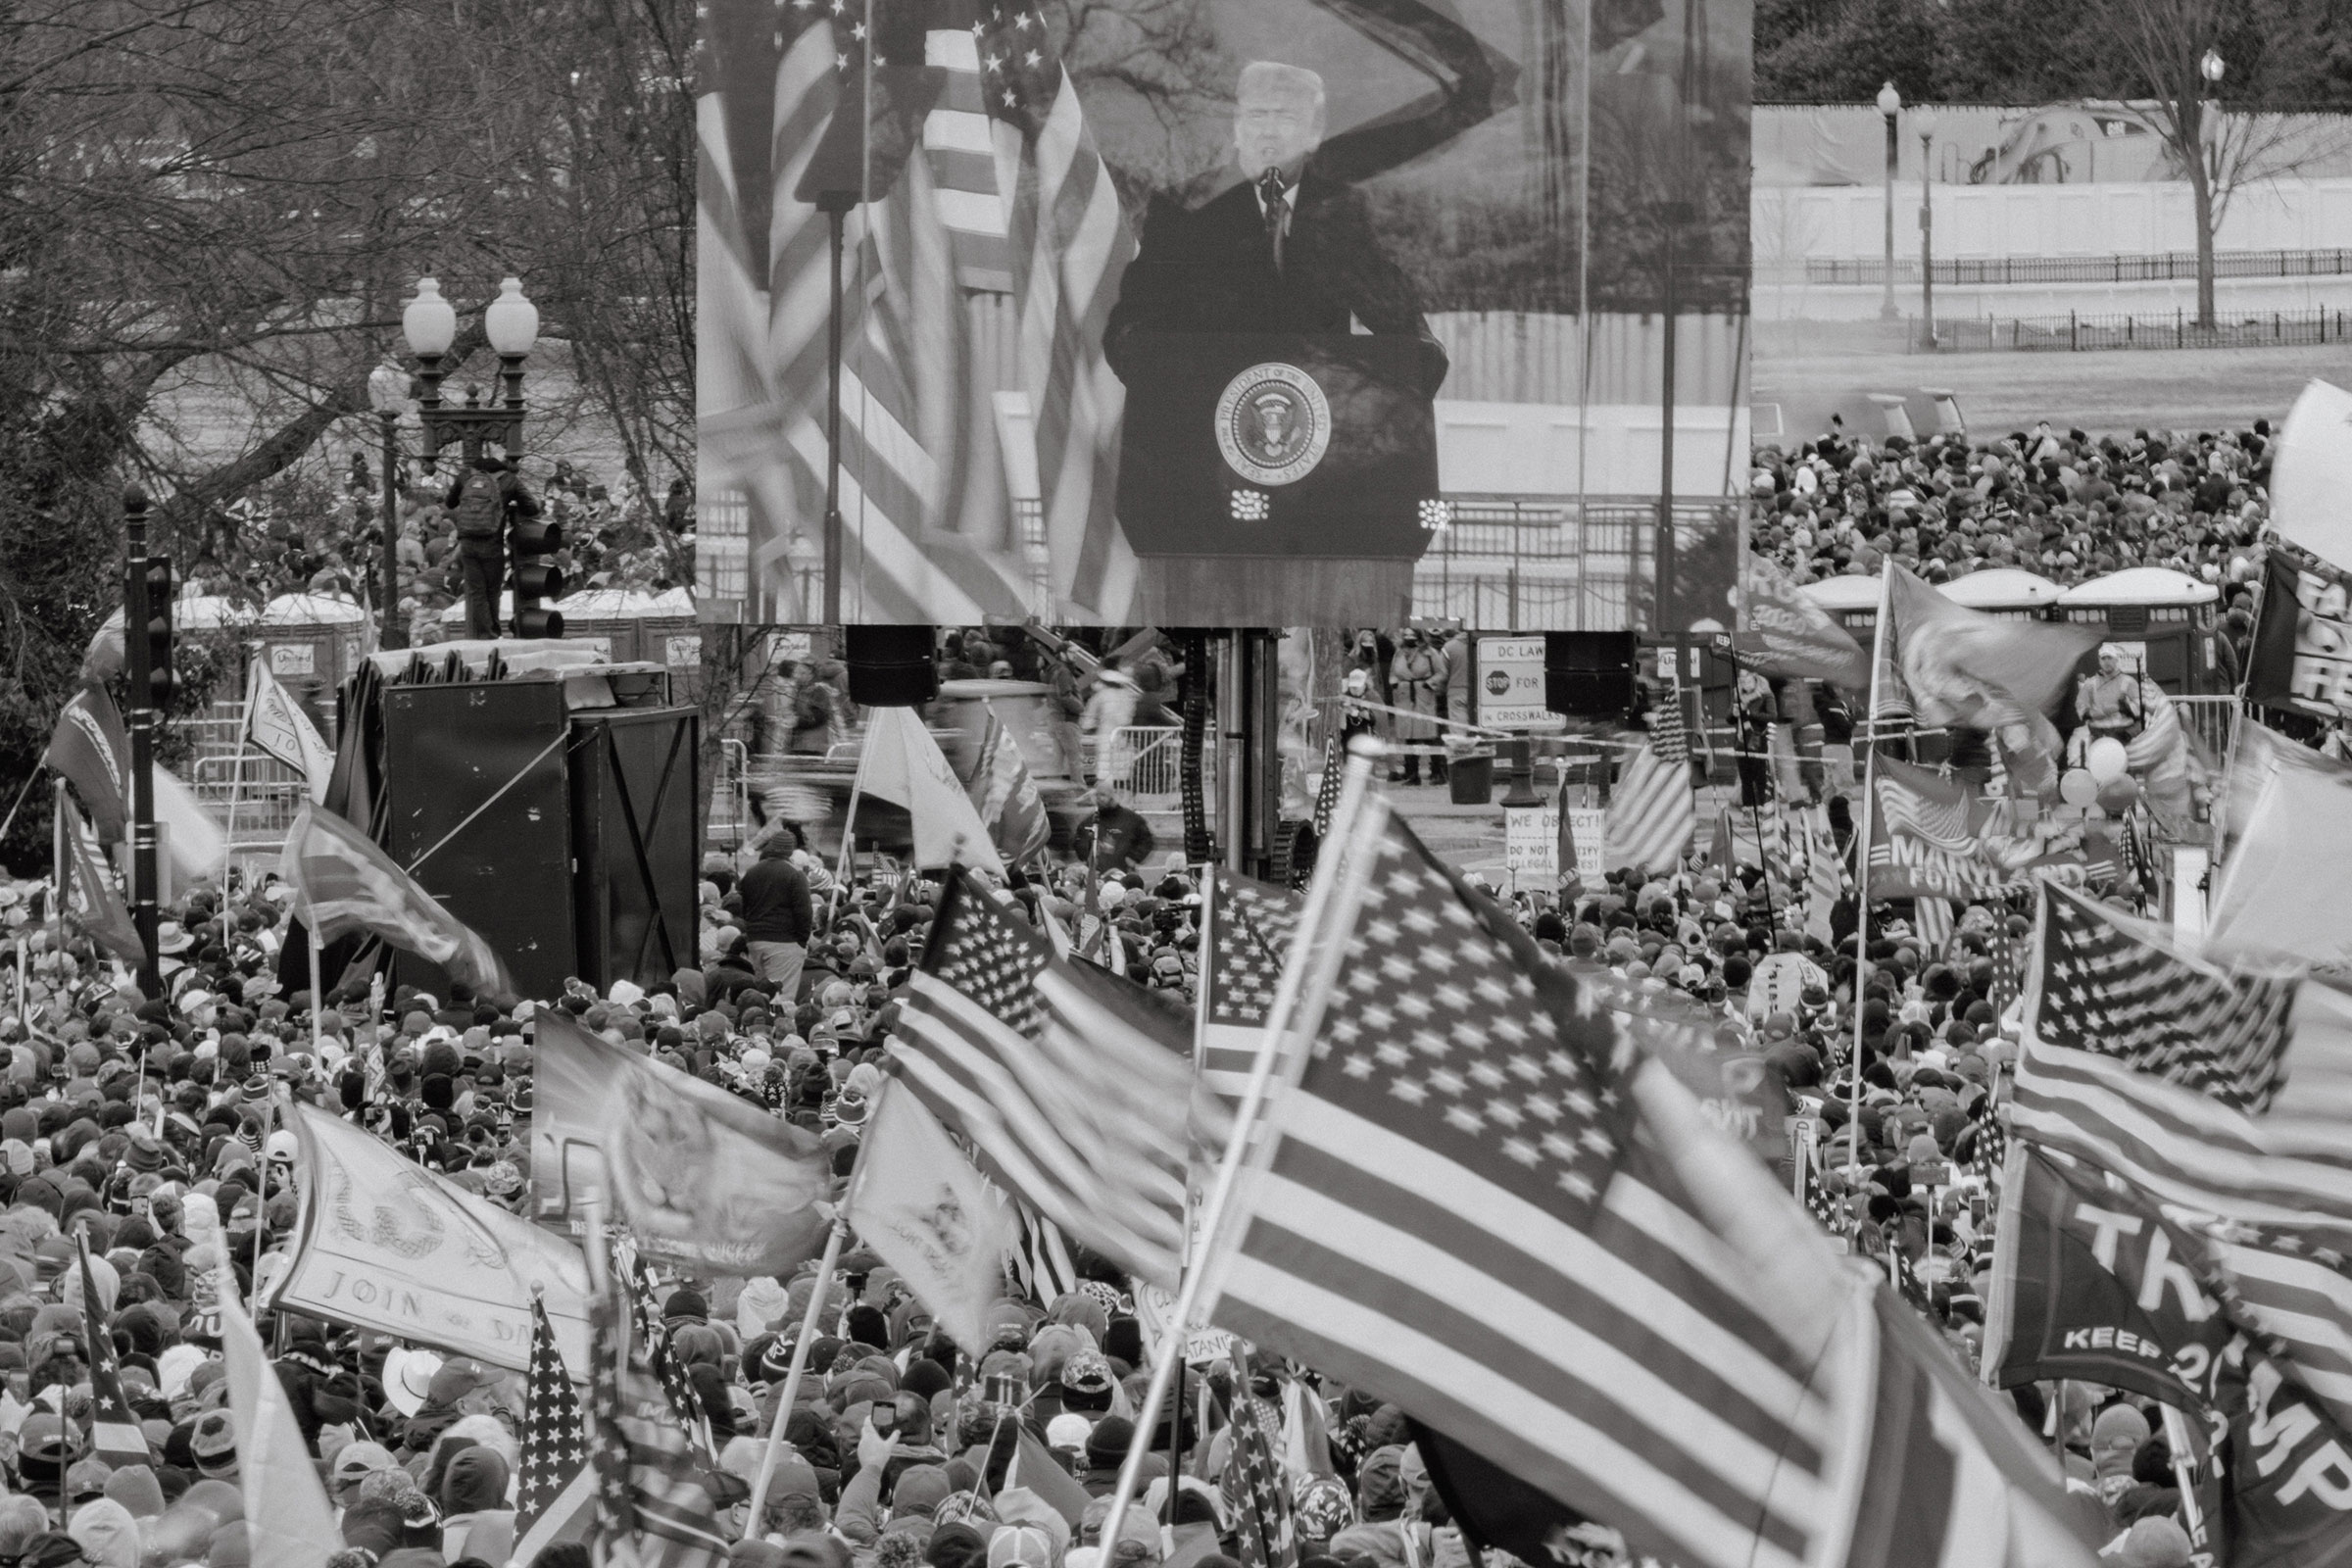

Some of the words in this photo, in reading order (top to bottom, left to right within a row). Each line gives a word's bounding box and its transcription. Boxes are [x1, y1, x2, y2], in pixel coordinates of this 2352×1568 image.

[1220, 368, 1271, 421] PRESIDENT
[1497, 646, 1513, 658] DC
[1486, 676, 1510, 689] STOP
[1516, 677, 1539, 689] FOR
[1510, 814, 1532, 828] WE
[1542, 814, 1600, 829] OBECT!
[1509, 845, 1523, 856] DO
[1530, 845, 1551, 856] NOT
[323, 1270, 421, 1317] JOIN
[2064, 1326, 2162, 1359] KEEP
